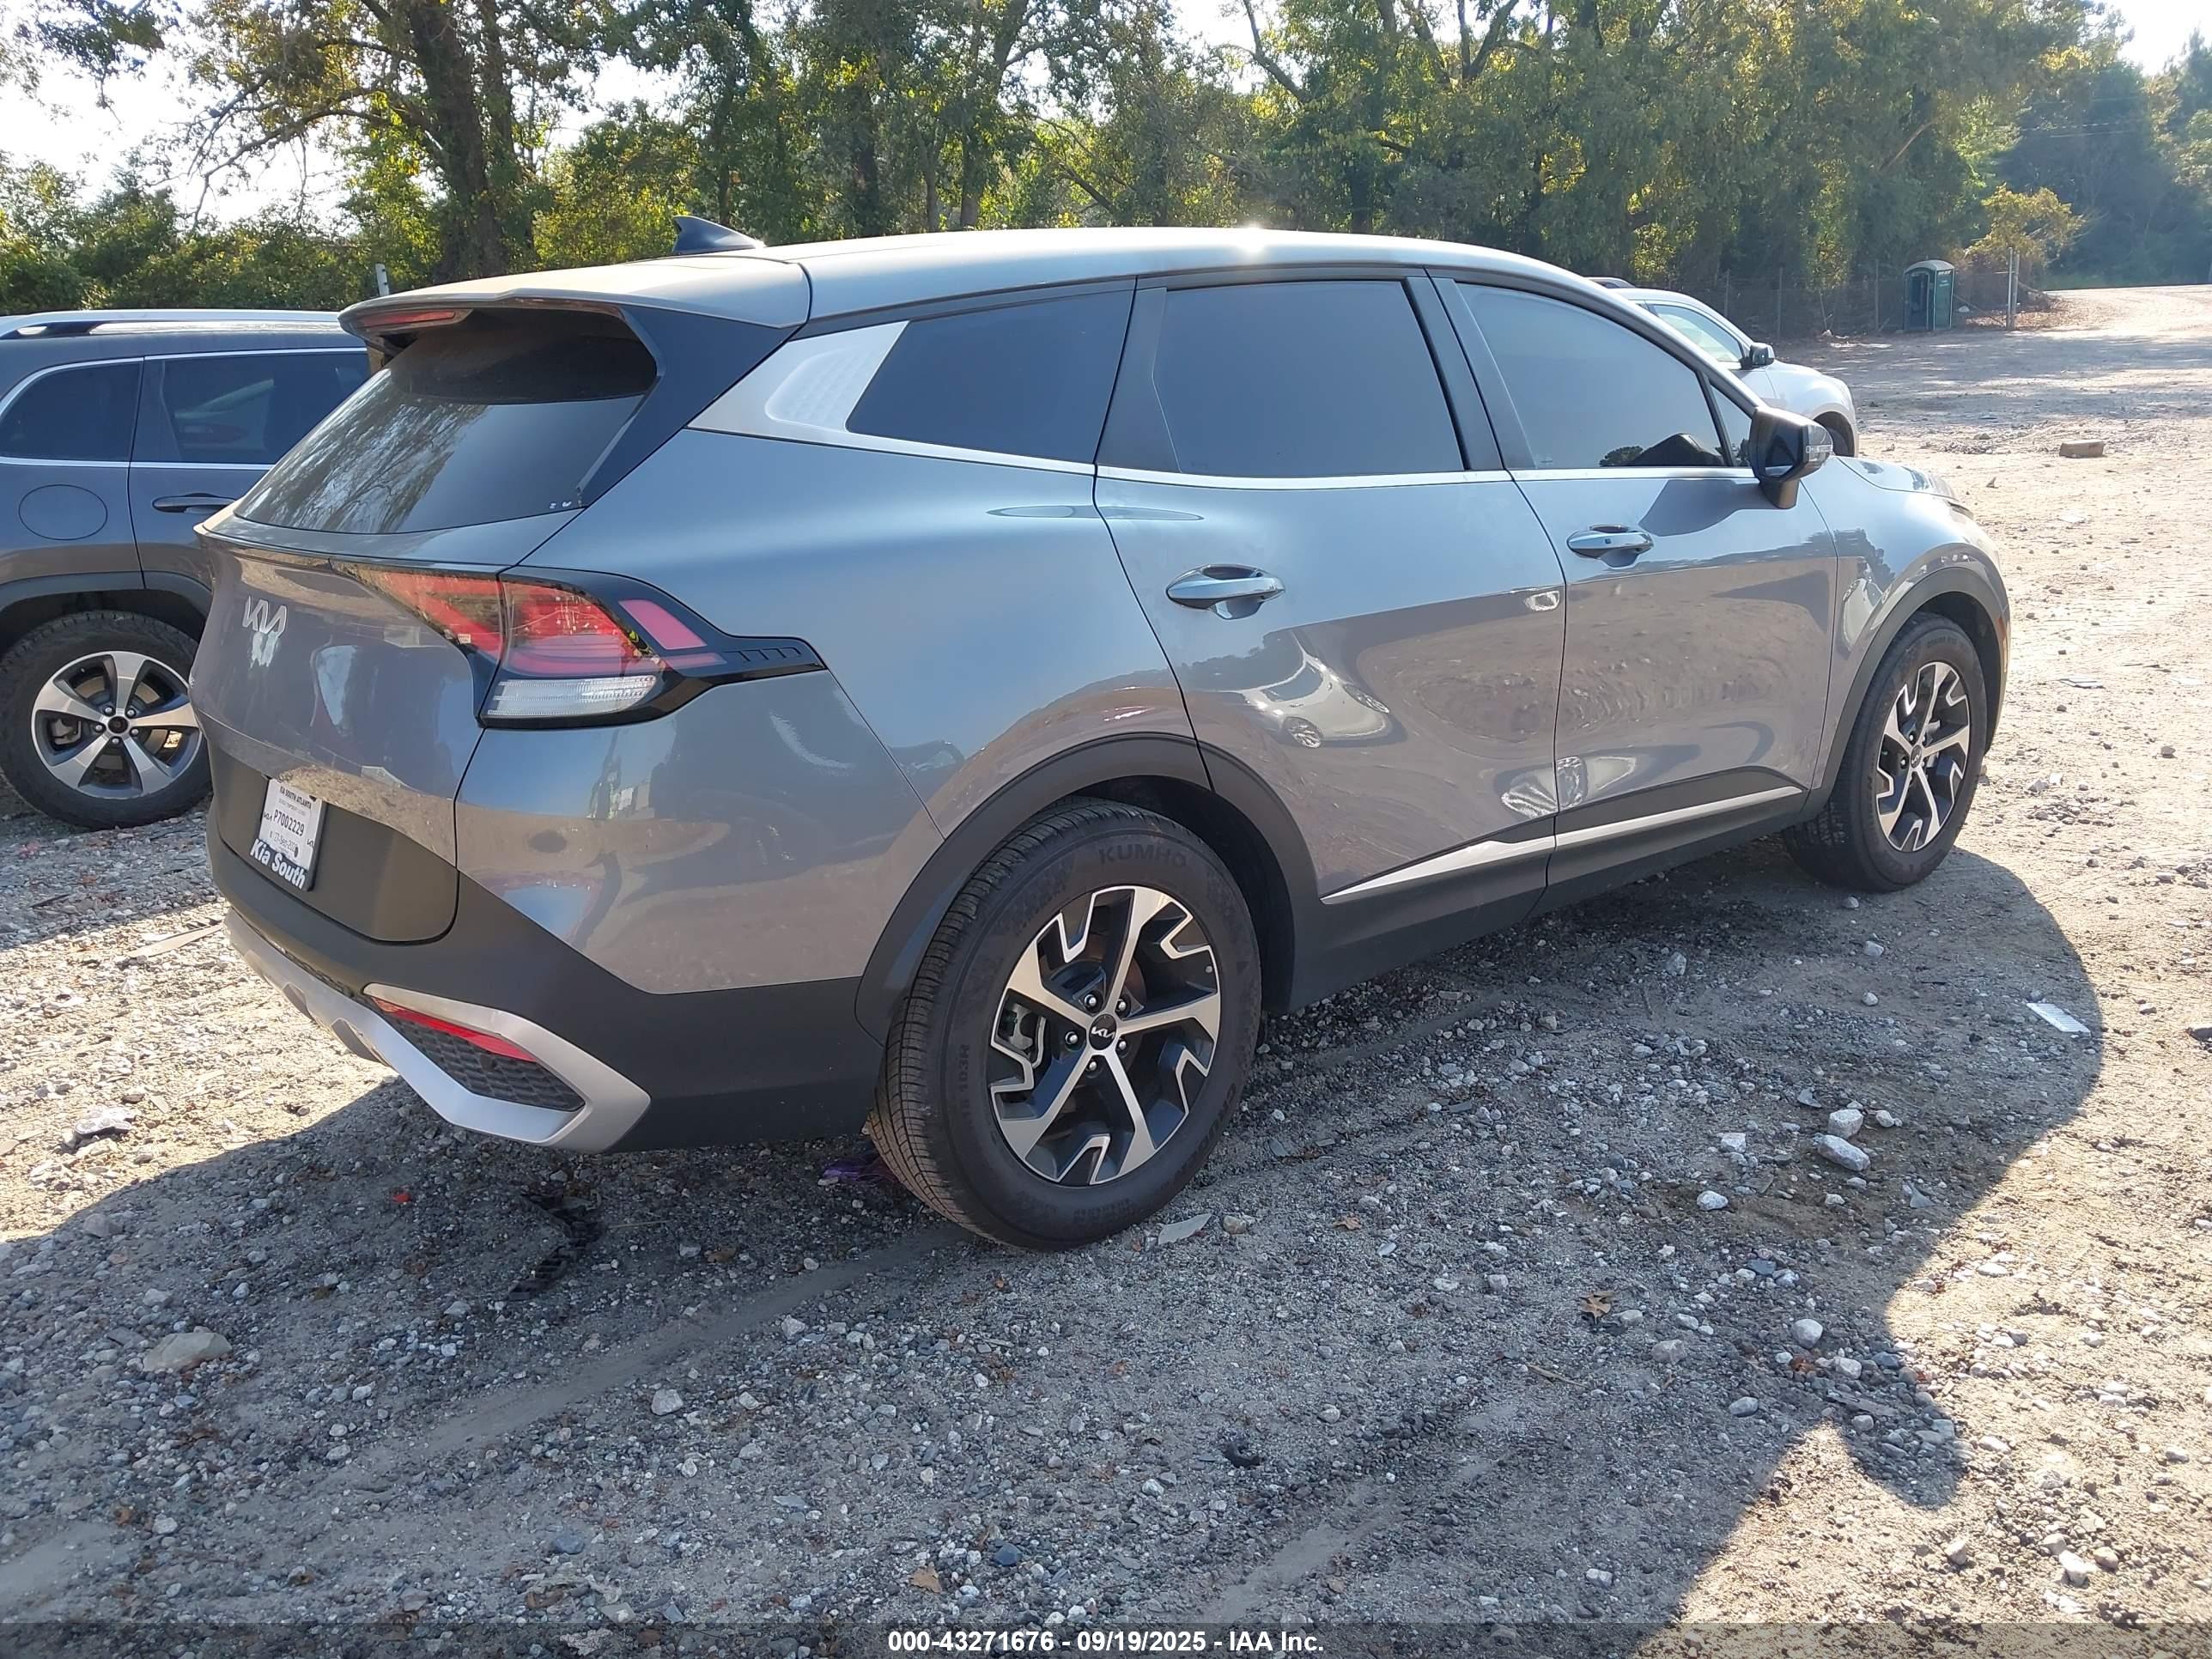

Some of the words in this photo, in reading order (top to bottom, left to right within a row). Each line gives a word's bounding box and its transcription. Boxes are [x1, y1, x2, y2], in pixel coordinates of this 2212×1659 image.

[242, 595, 287, 637] KIA
[285, 787, 296, 800] SOUTH
[296, 795, 312, 810] ATLANTA
[274, 809, 305, 836] P7002229
[274, 832, 298, 853] 27-Sep-202
[1099, 844, 1187, 866] KUMHO
[250, 838, 271, 866] Kia
[271, 853, 306, 890] South
